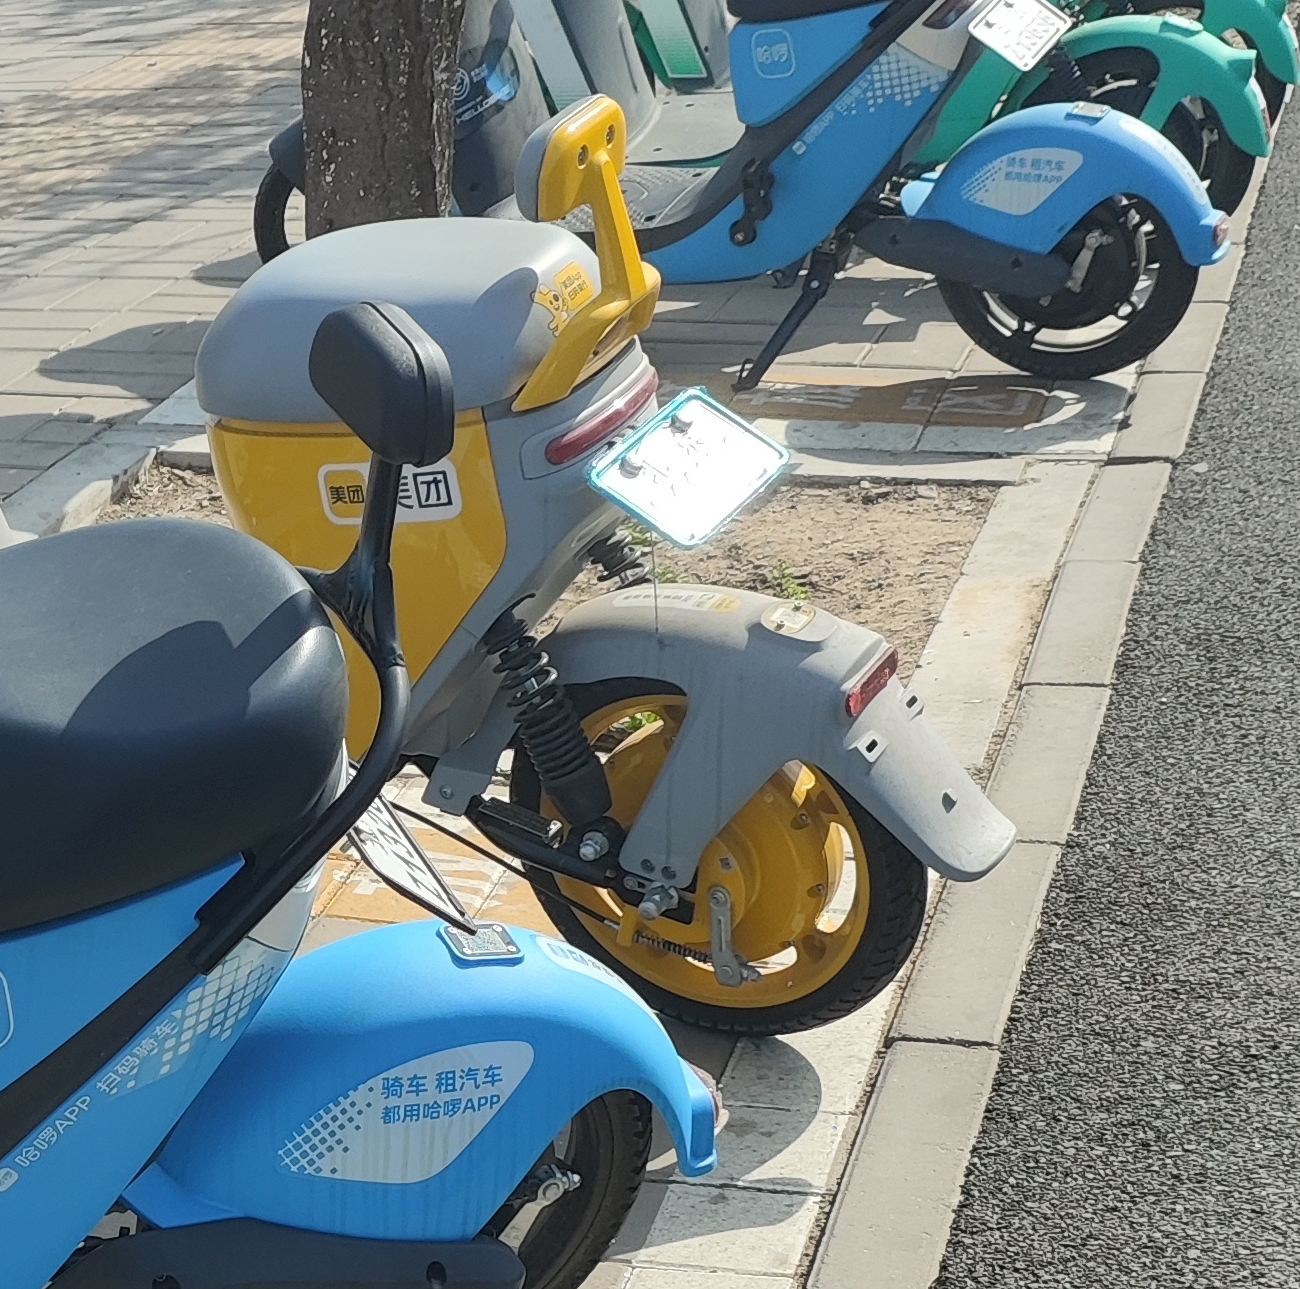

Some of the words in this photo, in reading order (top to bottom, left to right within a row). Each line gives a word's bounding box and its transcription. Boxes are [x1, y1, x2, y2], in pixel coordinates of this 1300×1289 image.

[14, 1095, 92, 1168] 哈啰APP
[96, 1018, 178, 1095] 扫码骑车
[380, 1073, 429, 1100] 骑车
[434, 1064, 504, 1095] 租汽车
[380, 1094, 501, 1125] 都用哈啰APP
